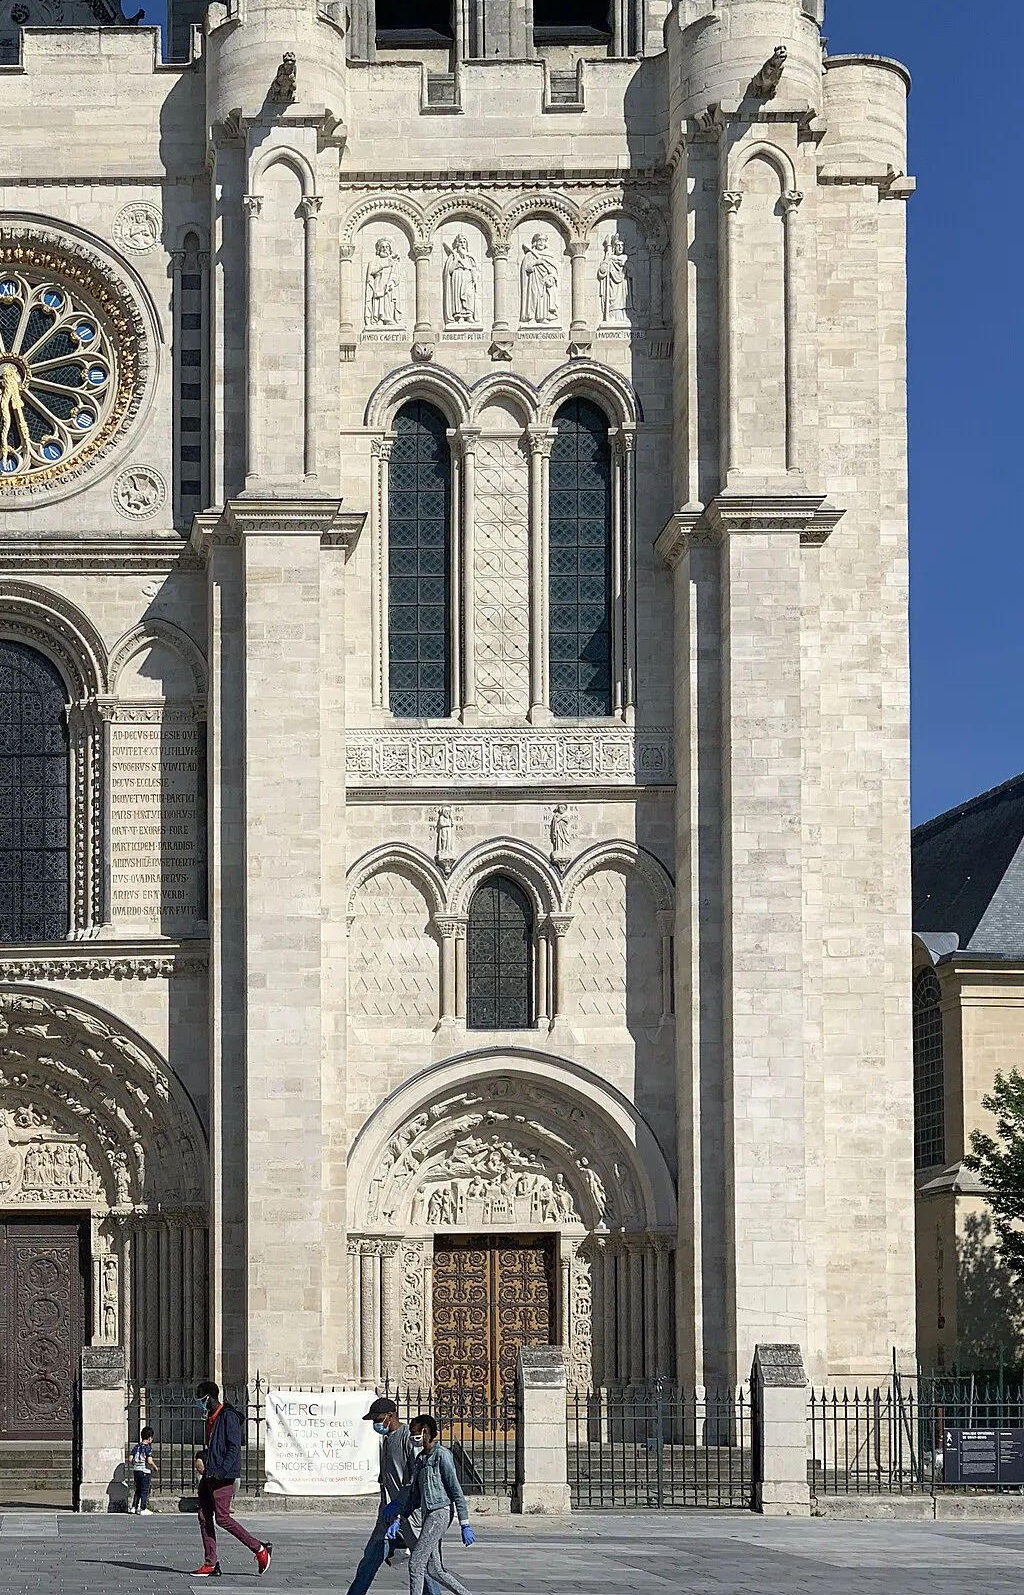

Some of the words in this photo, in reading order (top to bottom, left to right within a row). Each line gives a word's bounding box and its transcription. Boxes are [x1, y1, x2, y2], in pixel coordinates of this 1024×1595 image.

[275, 1403, 324, 1416] MERCI
[287, 1419, 325, 1427] TOUTES
[294, 1430, 318, 1438] TOUS
[326, 1430, 349, 1438] CEUX
[320, 1440, 358, 1448] TRAVAIL
[308, 1450, 320, 1458] LA
[323, 1450, 341, 1458] VIE
[275, 1462, 313, 1471] ENCORE
